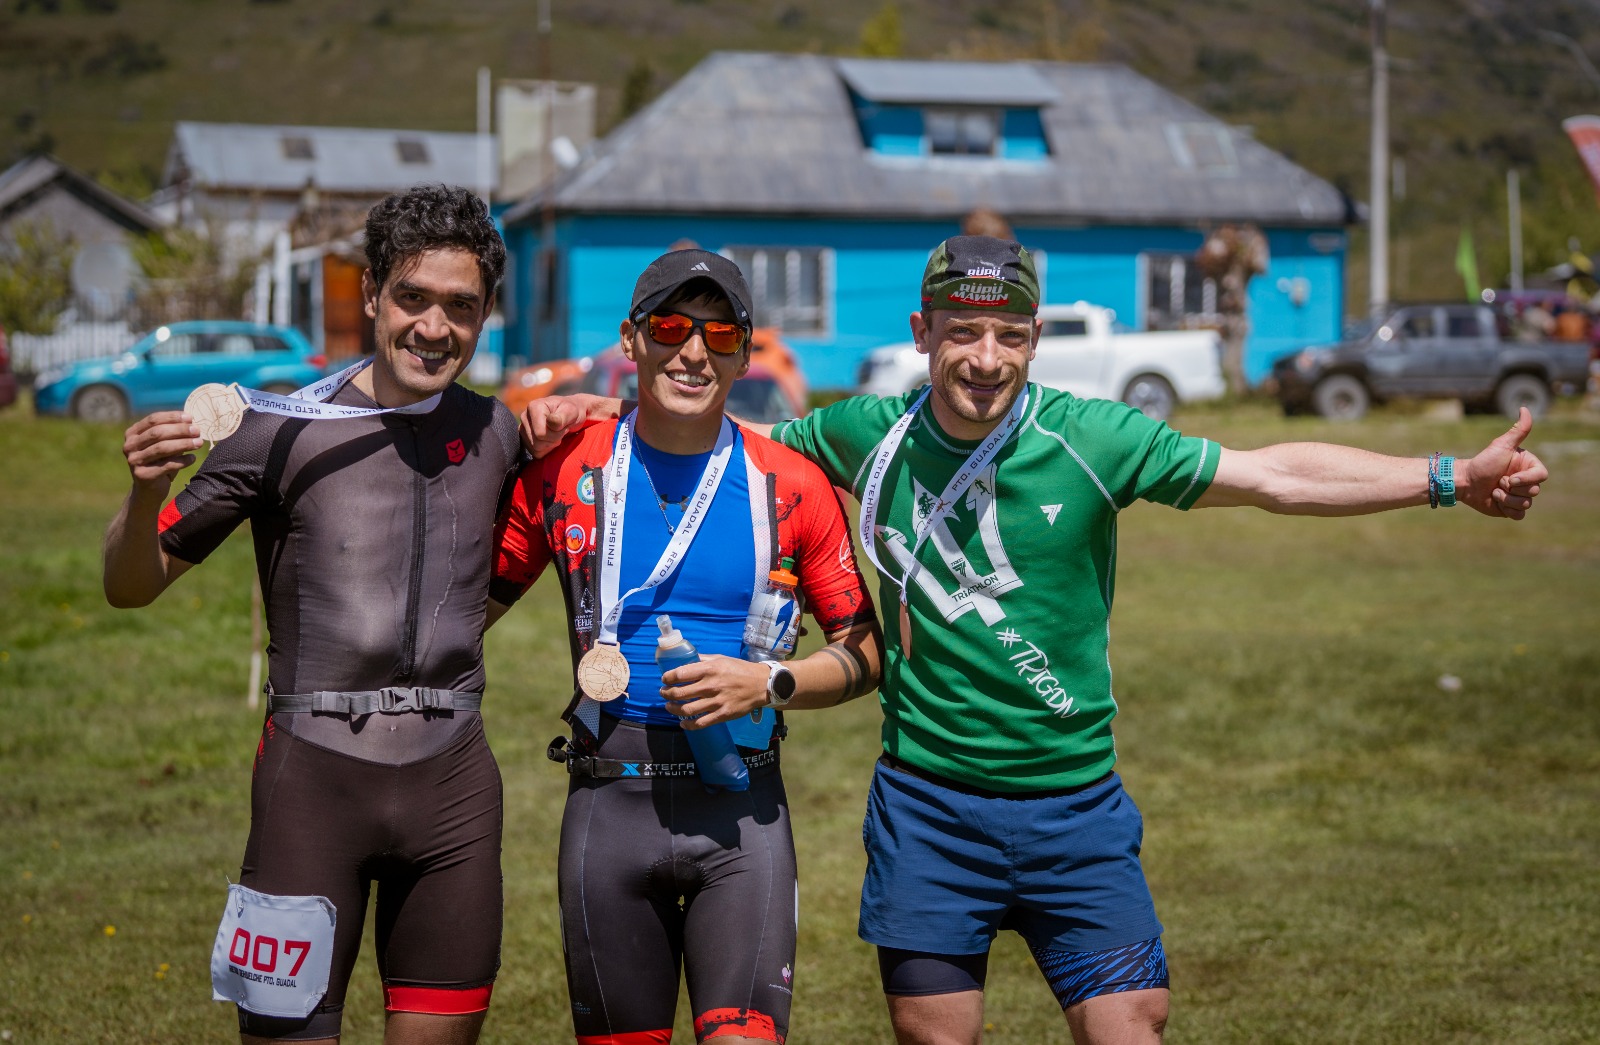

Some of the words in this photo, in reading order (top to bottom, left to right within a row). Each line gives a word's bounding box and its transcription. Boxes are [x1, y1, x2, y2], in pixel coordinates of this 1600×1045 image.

[295, 405, 321, 415] RETO
[873, 451, 890, 479] RETO
[951, 472, 971, 492] PTO.
[970, 432, 1005, 470] GUADAL
[705, 466, 719, 489] PTO.
[681, 492, 708, 535] GUADAL
[607, 512, 617, 567] FINISHER
[659, 551, 678, 578] RETO
[741, 750, 775, 764] TERRA
[229, 927, 312, 977] 007
[276, 978, 297, 988] GUADAL
